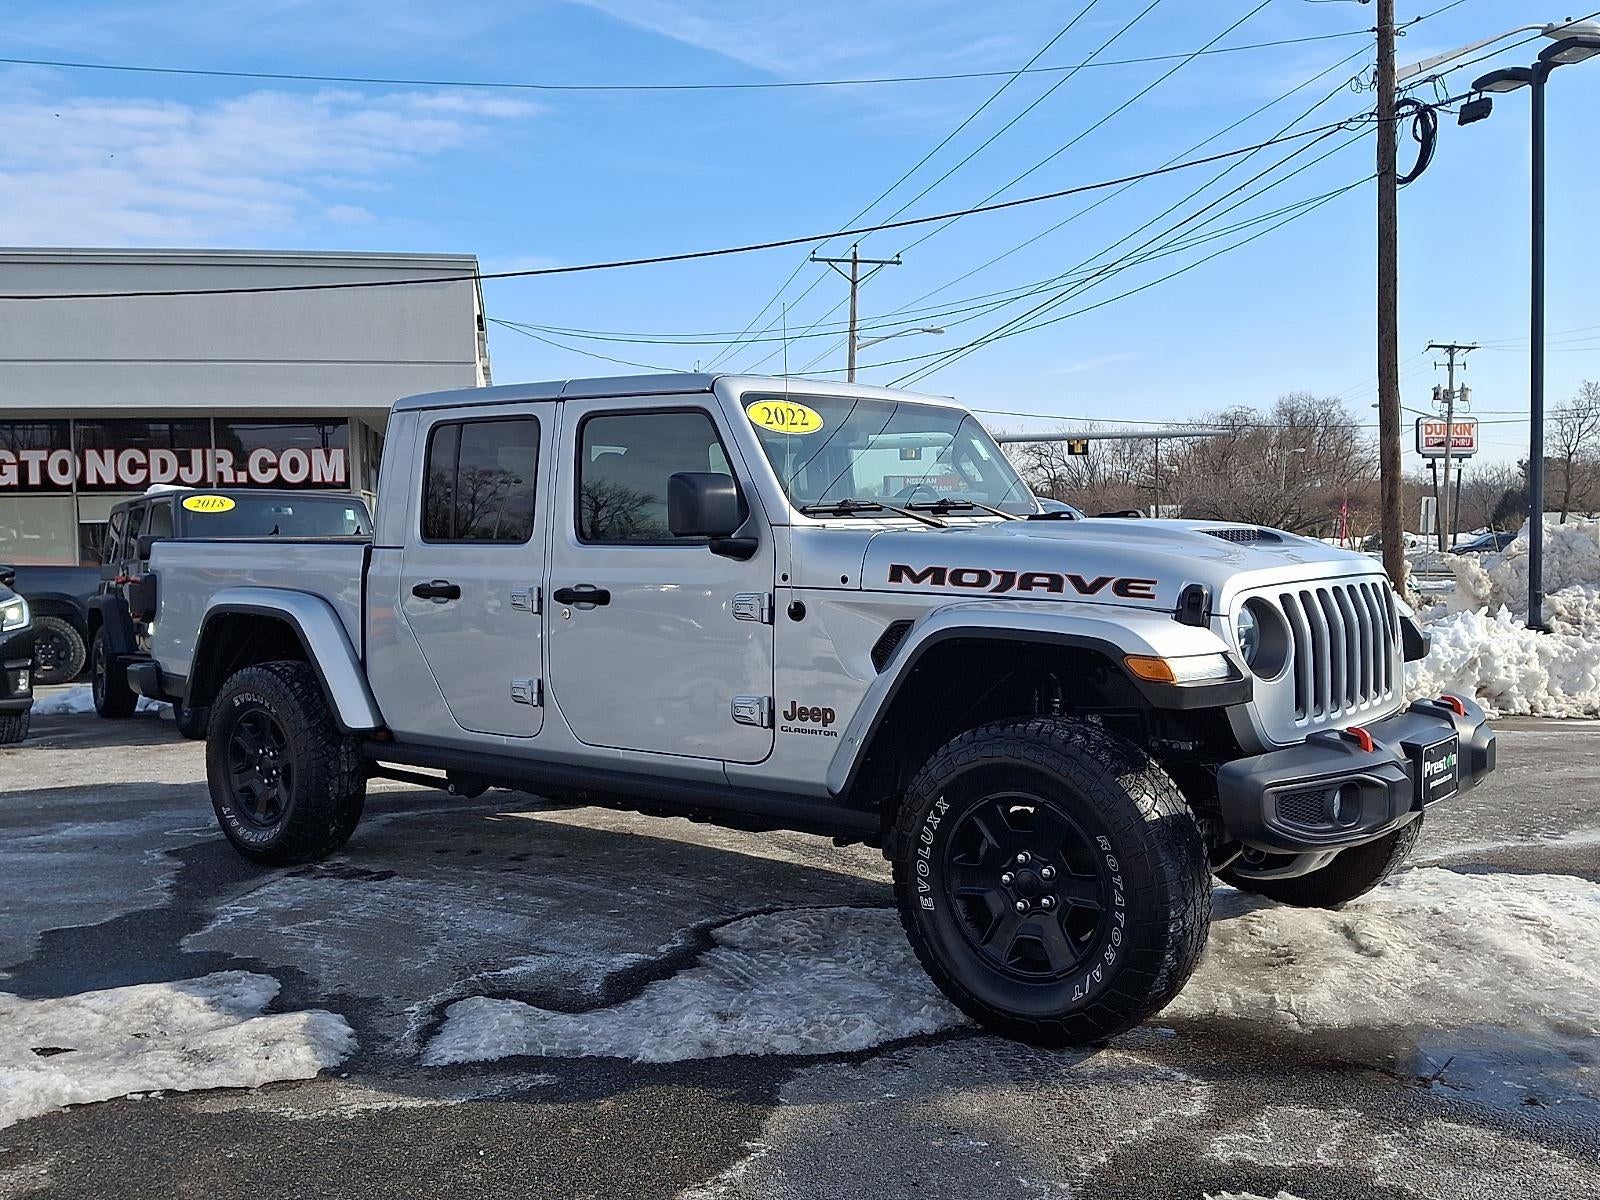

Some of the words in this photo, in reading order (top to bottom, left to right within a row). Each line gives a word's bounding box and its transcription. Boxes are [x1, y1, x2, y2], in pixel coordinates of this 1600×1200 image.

[763, 406, 809, 426] 2022
[1451, 438, 1471, 446] THRU
[193, 498, 226, 509] 2018
[888, 563, 1158, 600] MOJAVE
[782, 700, 836, 728] Jeep
[780, 725, 838, 738] GLADIATOR
[916, 795, 950, 910] EVOLUXX
[1096, 835, 1126, 966] ROTATOR
[1071, 963, 1102, 1002] A/T
